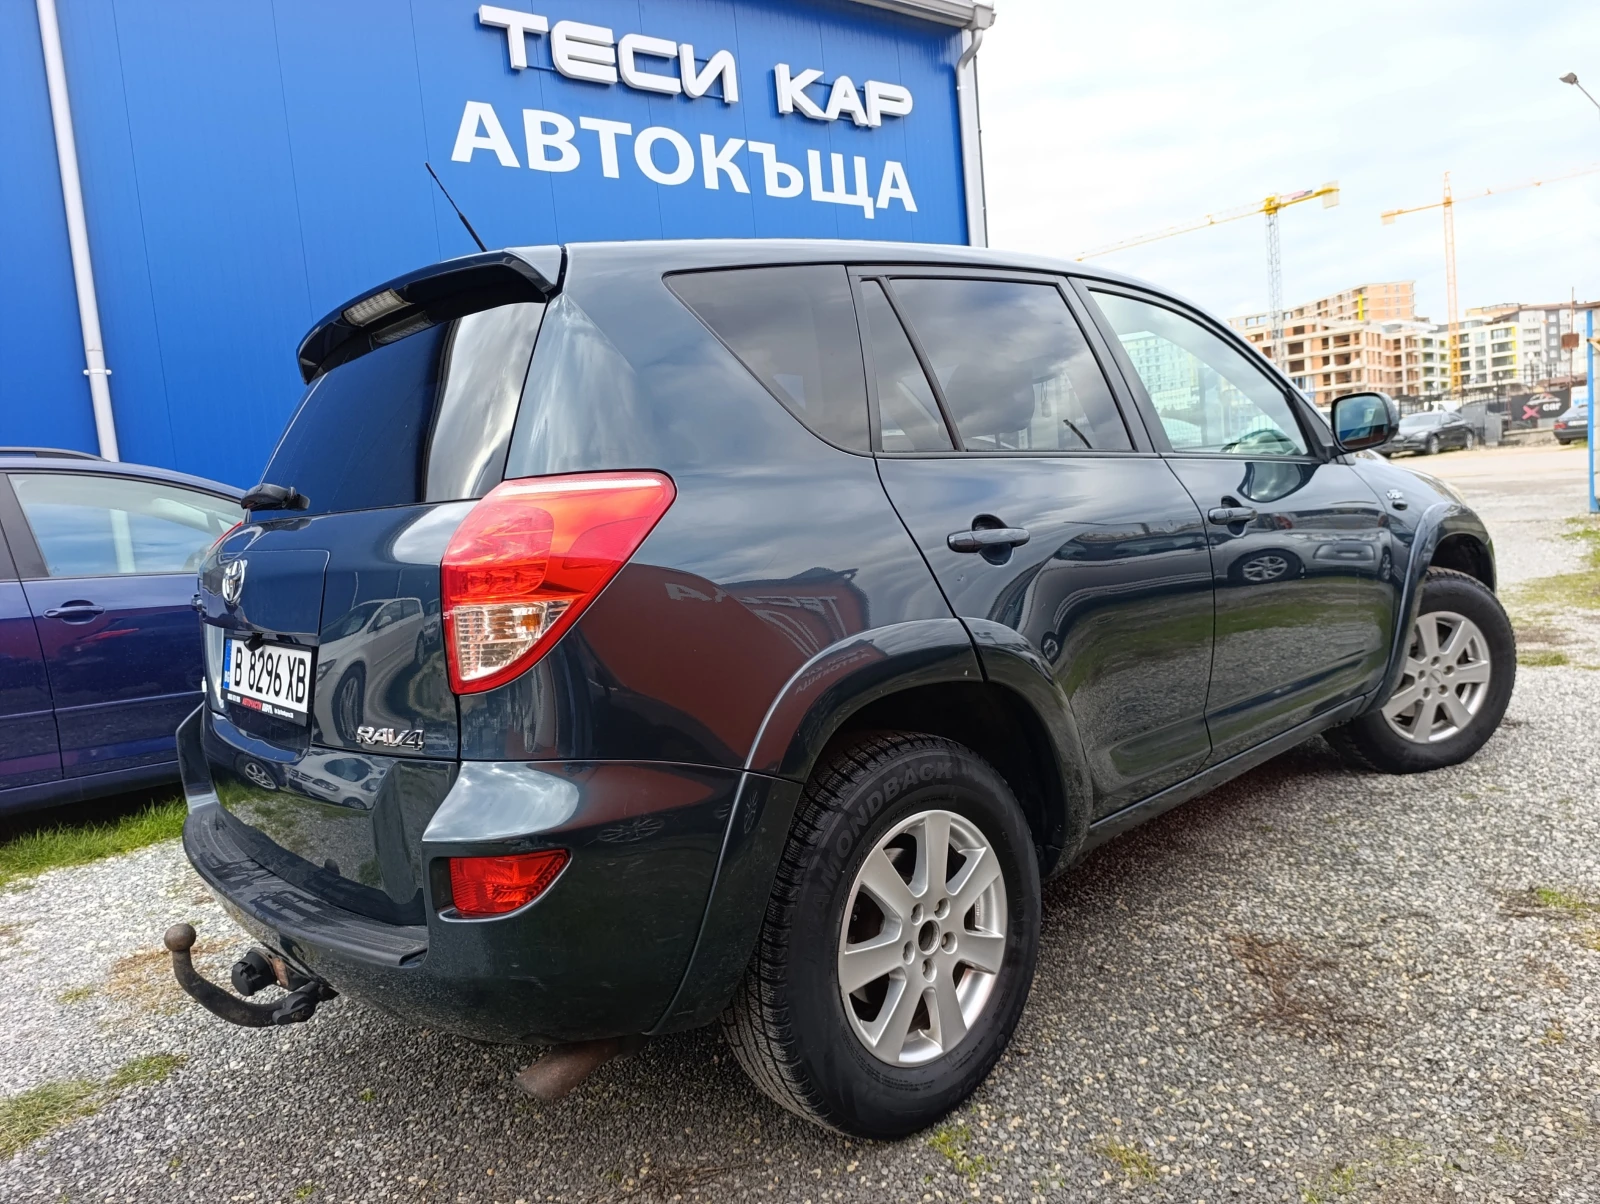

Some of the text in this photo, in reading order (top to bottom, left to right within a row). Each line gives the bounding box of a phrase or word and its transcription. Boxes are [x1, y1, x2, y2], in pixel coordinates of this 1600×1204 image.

[479, 5, 913, 128] ТЕСИ КАР
[451, 100, 918, 219] АВТОКЪЩА
[234, 647, 306, 704] B 8296 XB
[356, 726, 425, 751] RAV4
